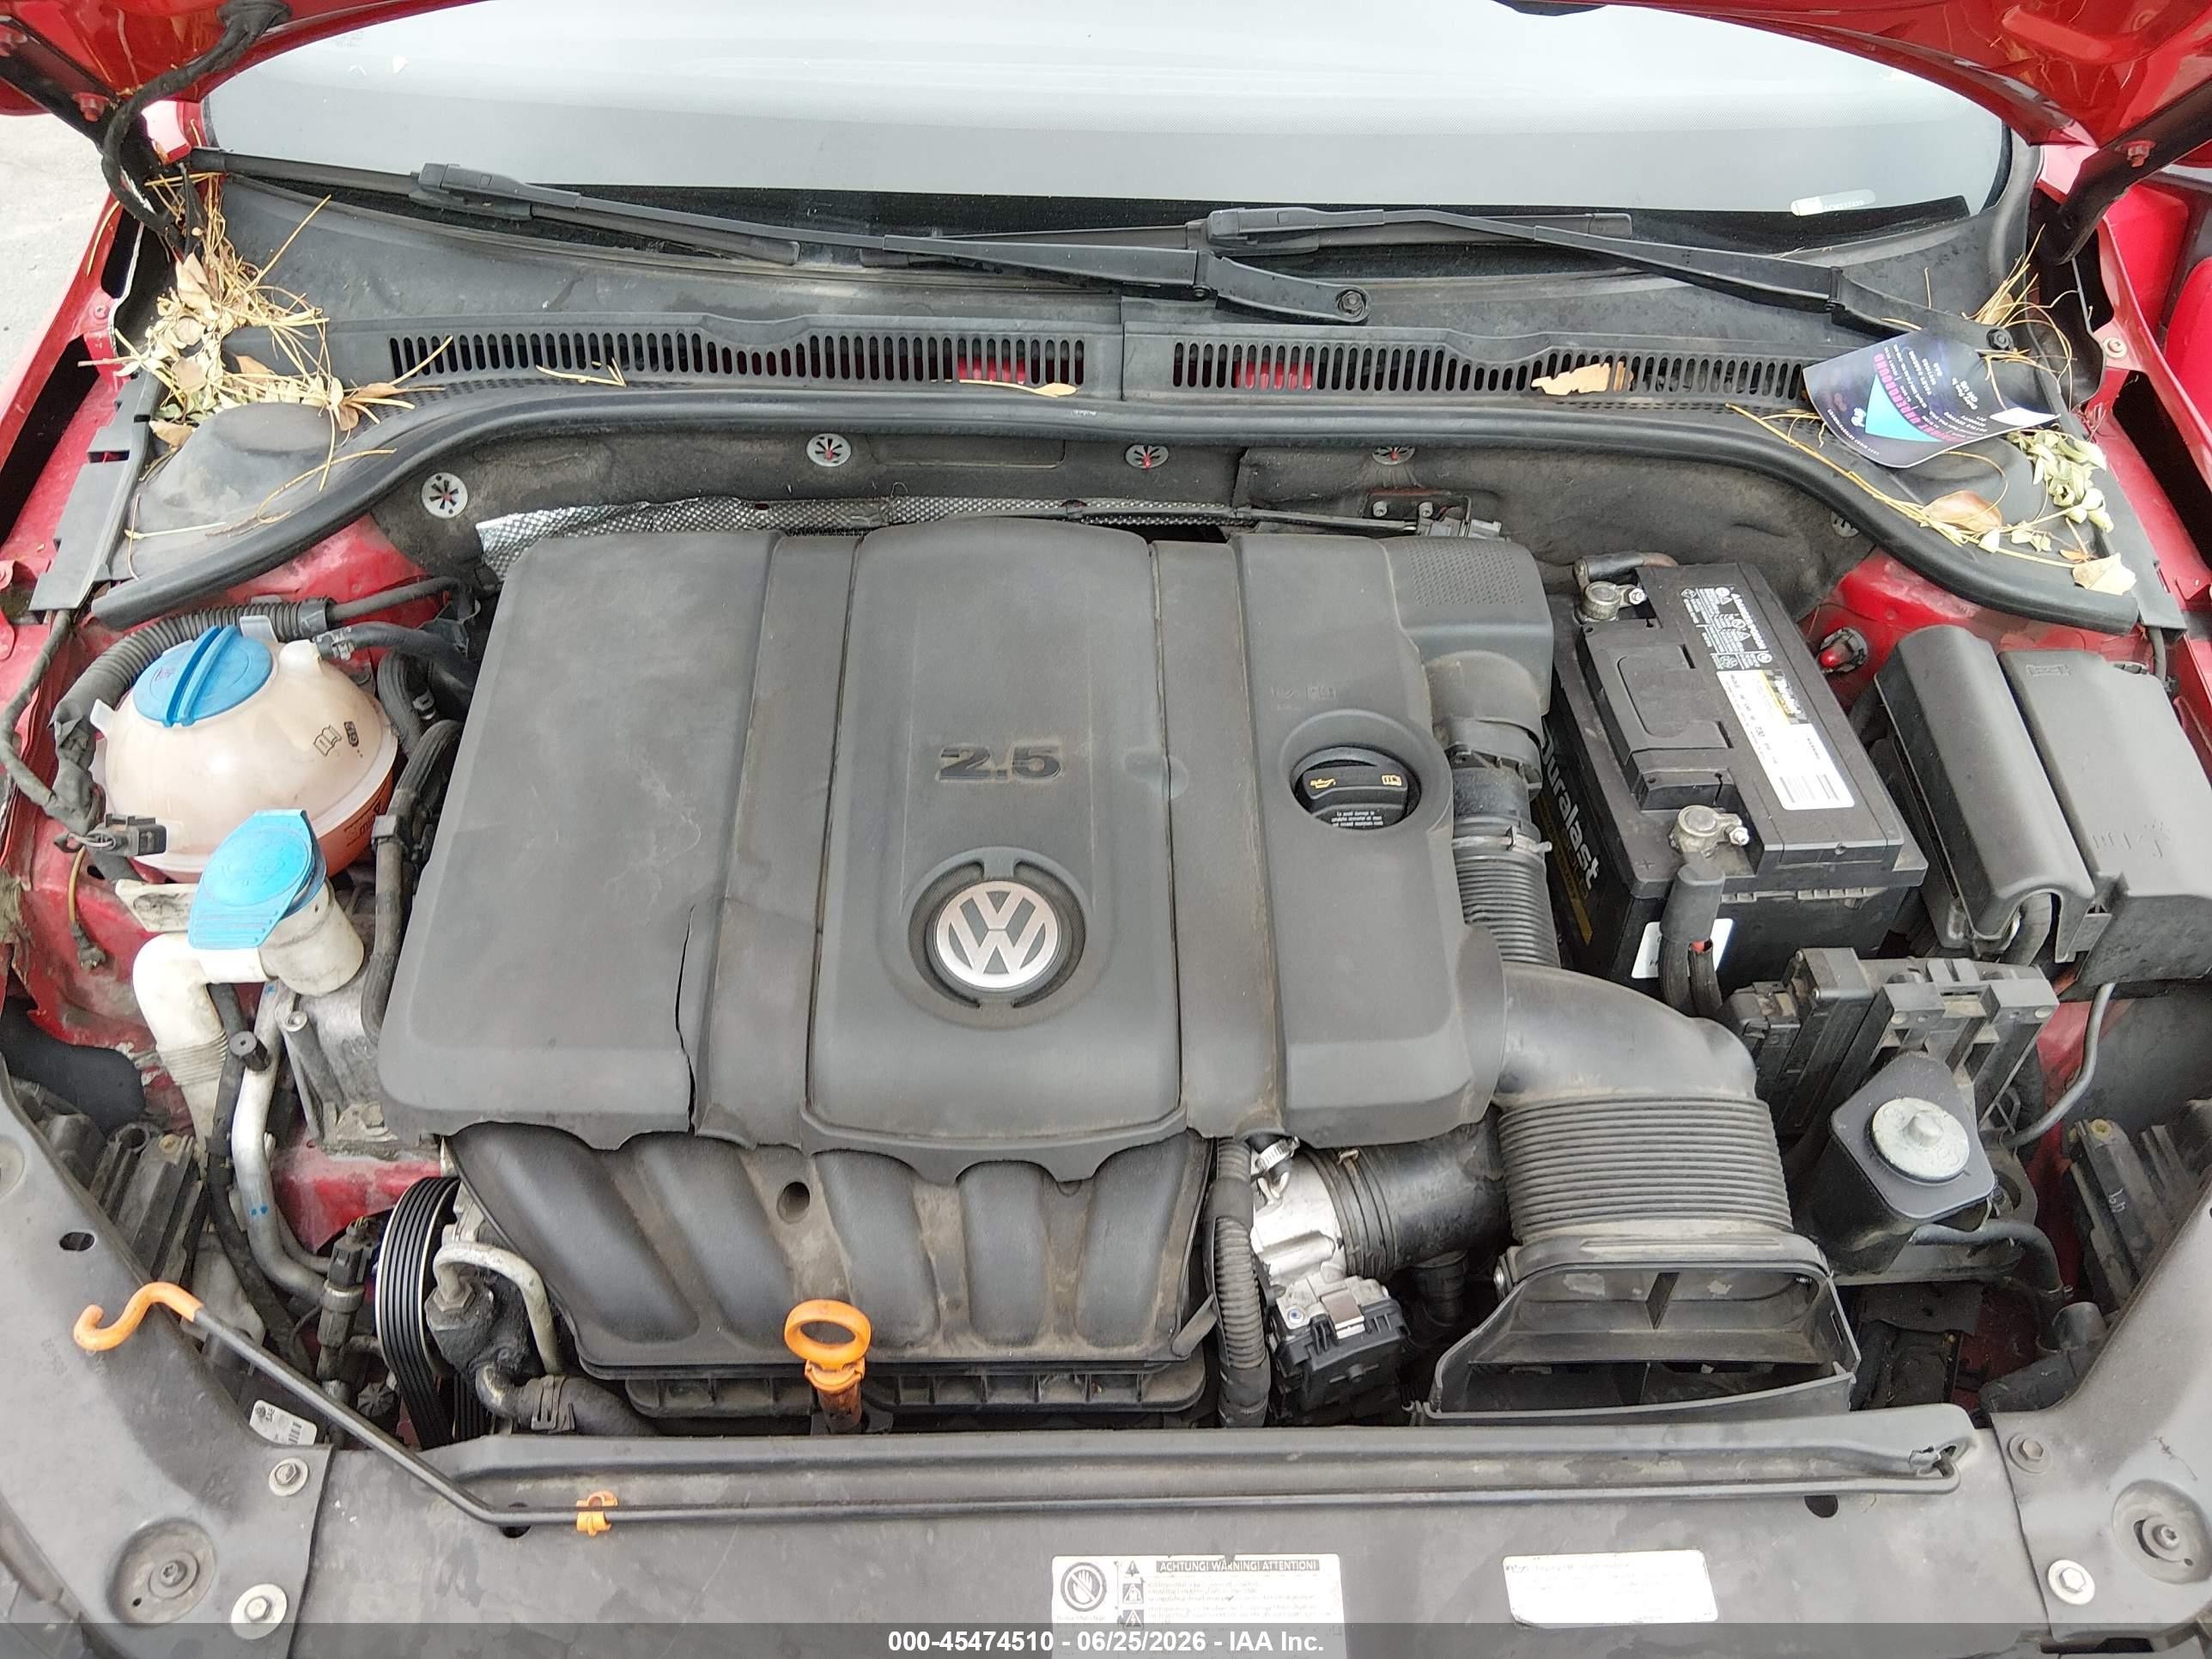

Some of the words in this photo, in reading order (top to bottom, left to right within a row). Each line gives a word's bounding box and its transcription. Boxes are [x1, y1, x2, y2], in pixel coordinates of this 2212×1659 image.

[939, 744, 1062, 781] 2.5
[1160, 1561, 1208, 1571] ACHTUNG!
[1212, 1561, 1260, 1571] WARNING!
[1263, 1561, 1317, 1571] ATTENTION!
